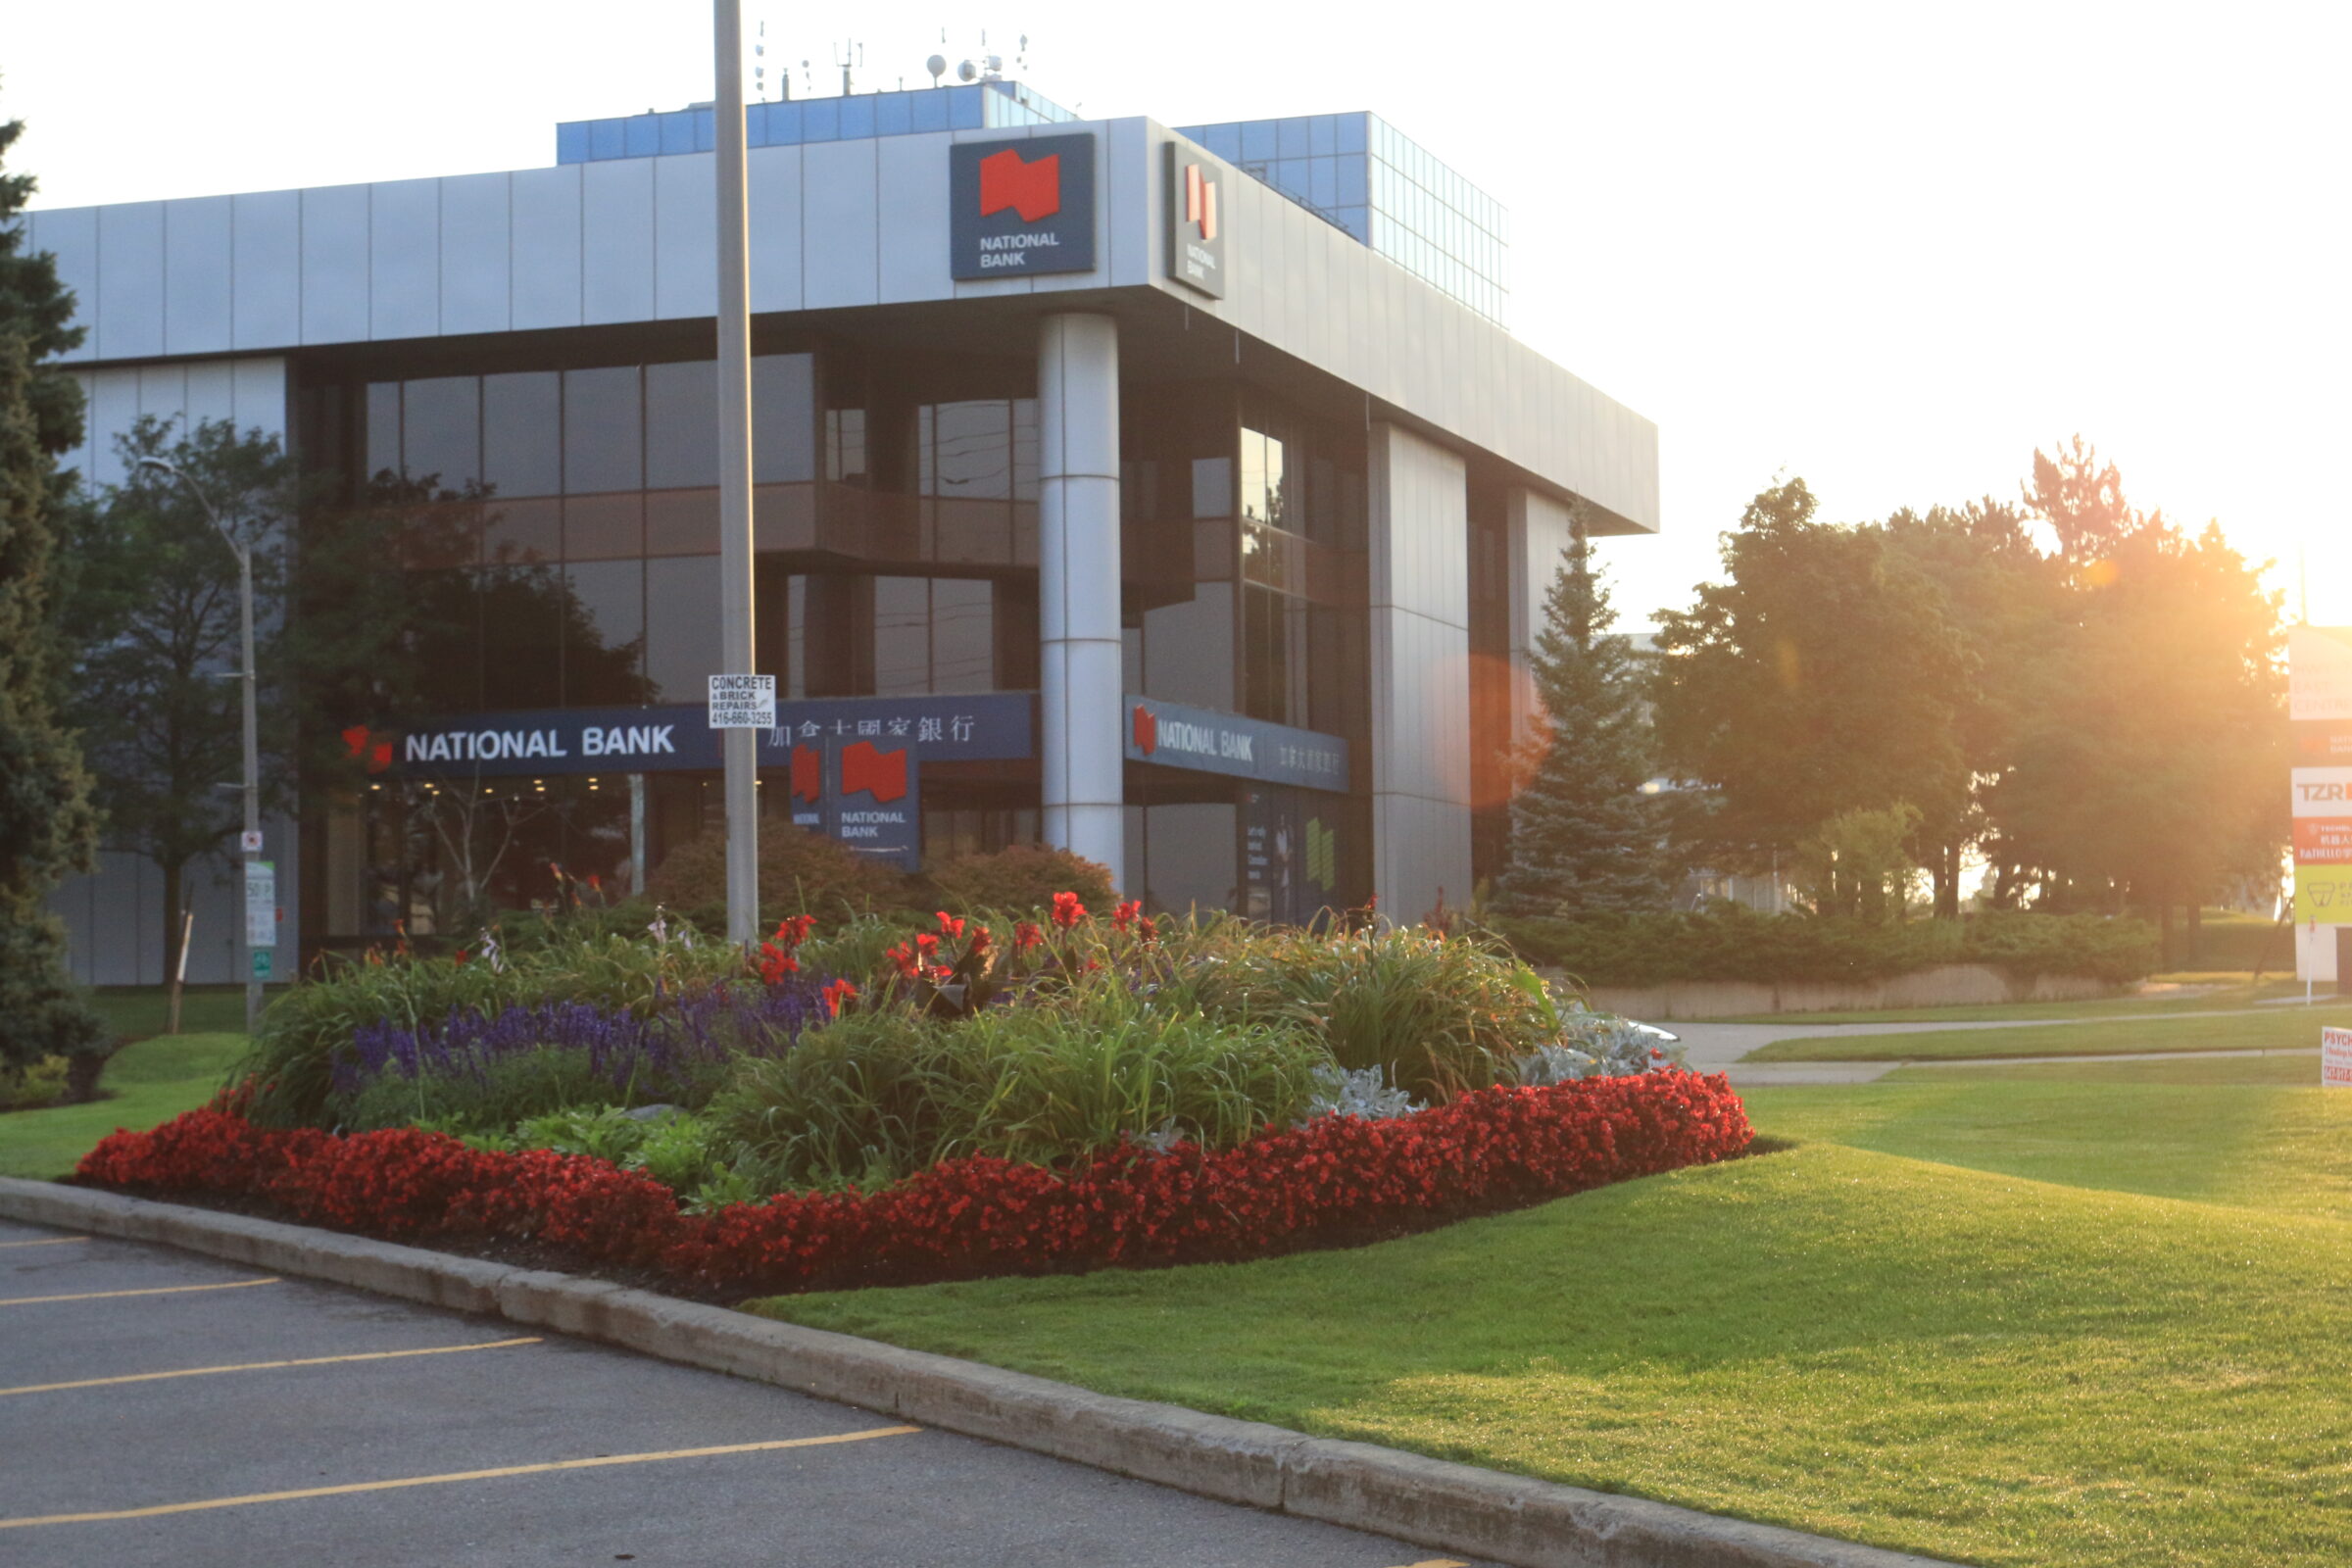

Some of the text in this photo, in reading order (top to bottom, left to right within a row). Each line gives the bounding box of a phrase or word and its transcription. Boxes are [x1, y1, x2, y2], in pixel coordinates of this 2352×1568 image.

[980, 232, 1059, 251] NATIONAL
[980, 252, 1025, 269] BANK
[1187, 244, 1216, 270] NATIONAL
[1187, 260, 1204, 280] BANK
[711, 676, 771, 690] CONCRETE
[720, 691, 756, 700] BRICK
[712, 701, 757, 710] REPAIRS
[406, 724, 675, 761] NATIONAL BANK
[1158, 719, 1253, 762] NATIONAL BANK
[841, 811, 906, 823] NATIONAL
[841, 825, 878, 838] BANK
